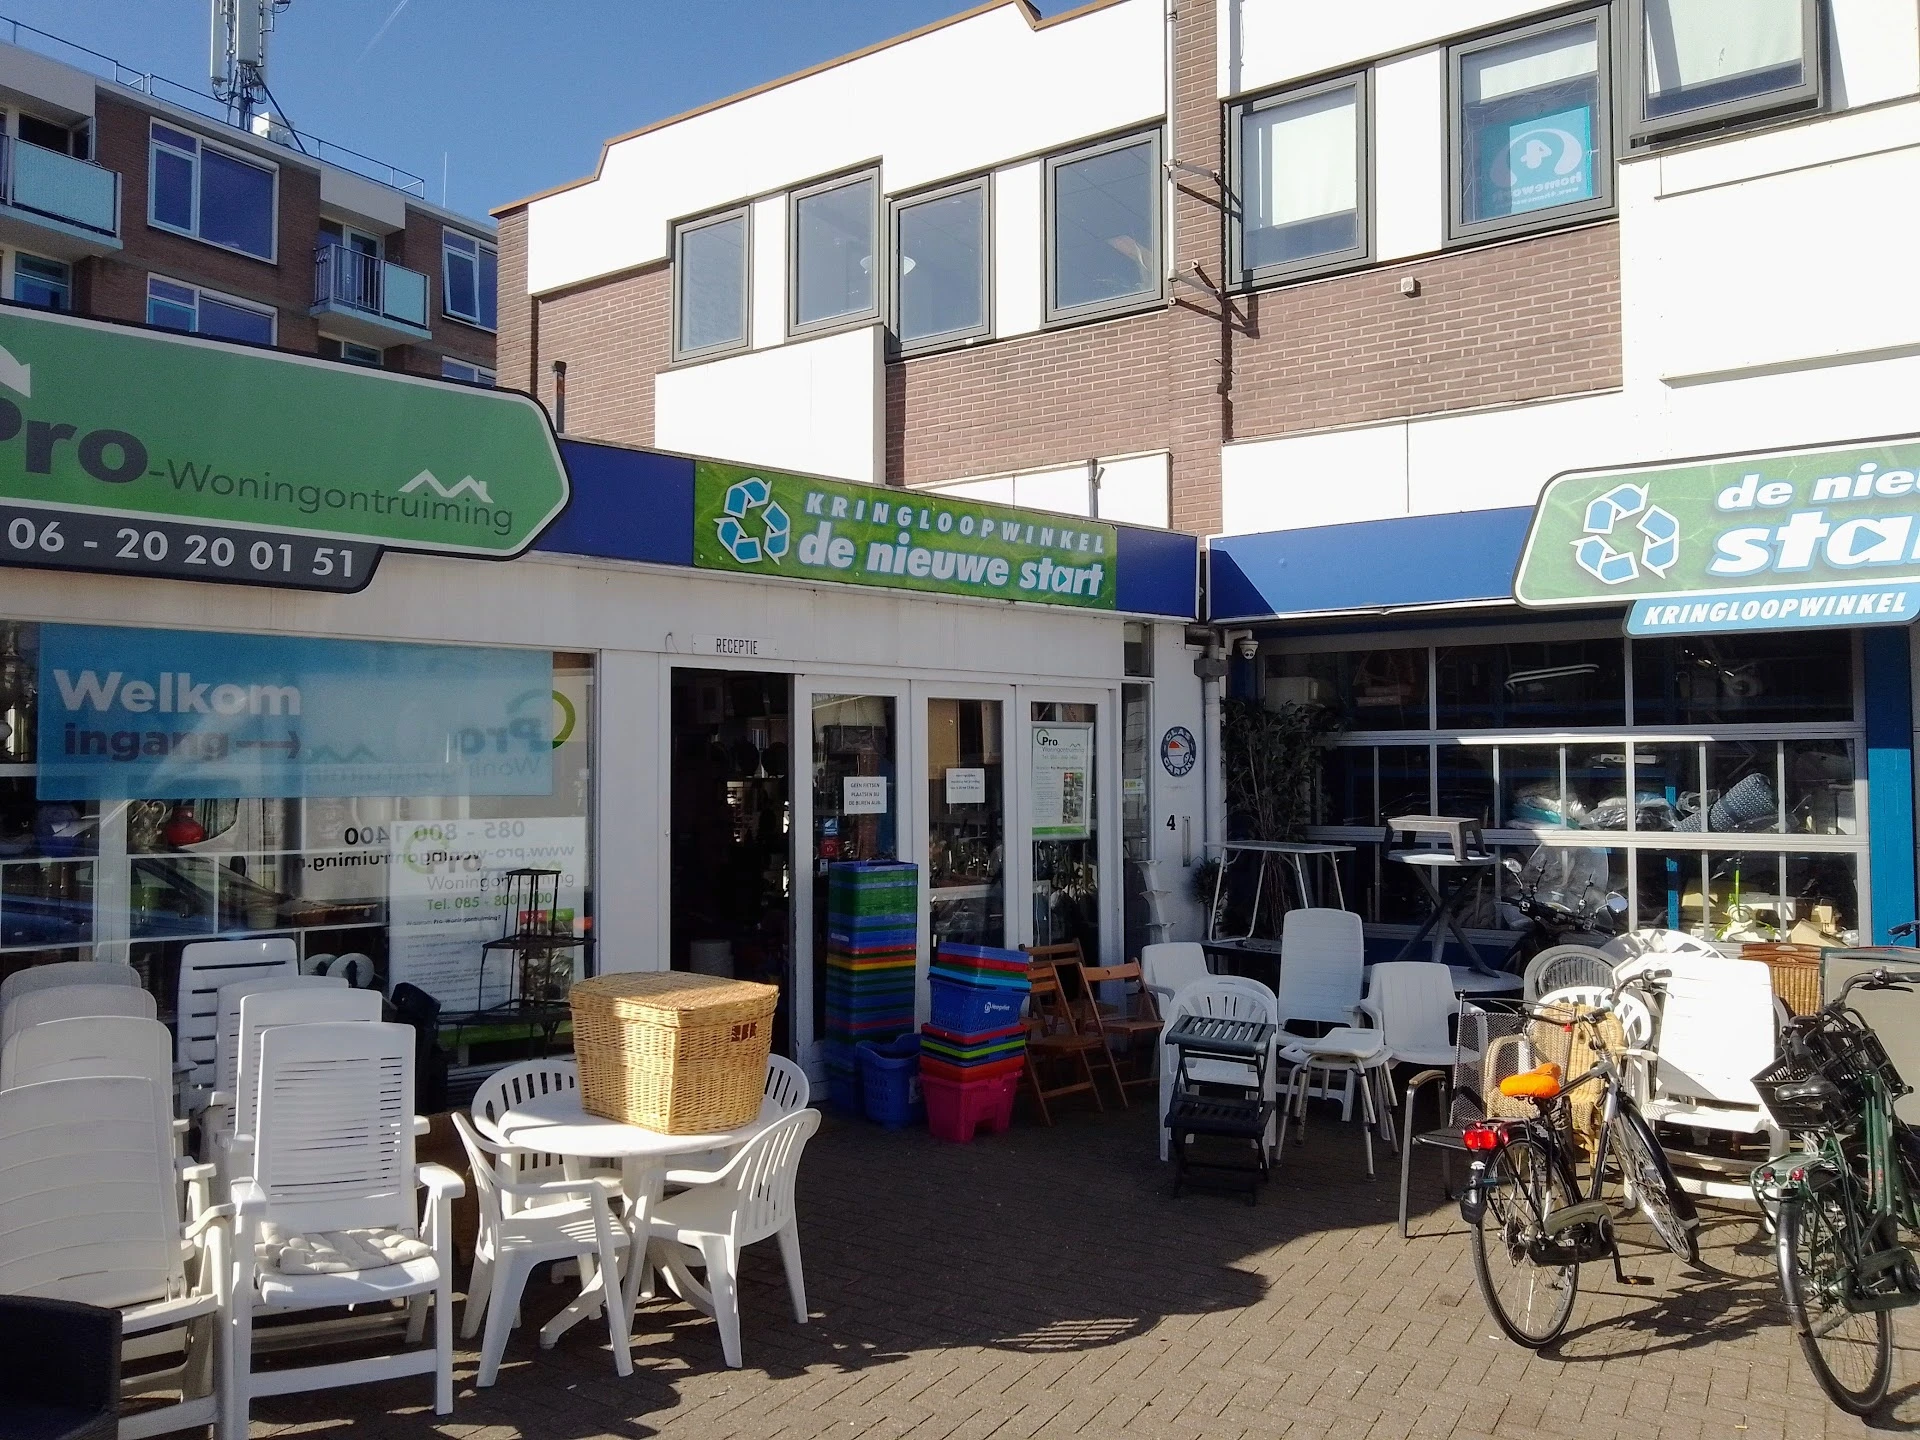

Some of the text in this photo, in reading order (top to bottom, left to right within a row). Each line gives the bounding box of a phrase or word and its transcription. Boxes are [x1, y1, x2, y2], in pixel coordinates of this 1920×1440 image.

[1717, 462, 1920, 510] de nie
[805, 492, 1106, 554] KRINGLOOPWINKEL
[1709, 511, 1920, 574] sta
[7, 517, 66, 552] 06
[115, 527, 169, 561] 20
[183, 534, 235, 567] 20
[249, 541, 293, 572] 01
[311, 548, 354, 578] 51
[798, 521, 1104, 596] de nieuwe start
[1643, 591, 1907, 626] KRINGLOOPWINKEL
[716, 638, 758, 655] RECEPTIE
[53, 669, 301, 716] Welkom
[64, 722, 229, 762] ingang
[1166, 815, 1176, 830] 4
[454, 897, 480, 909] 085
